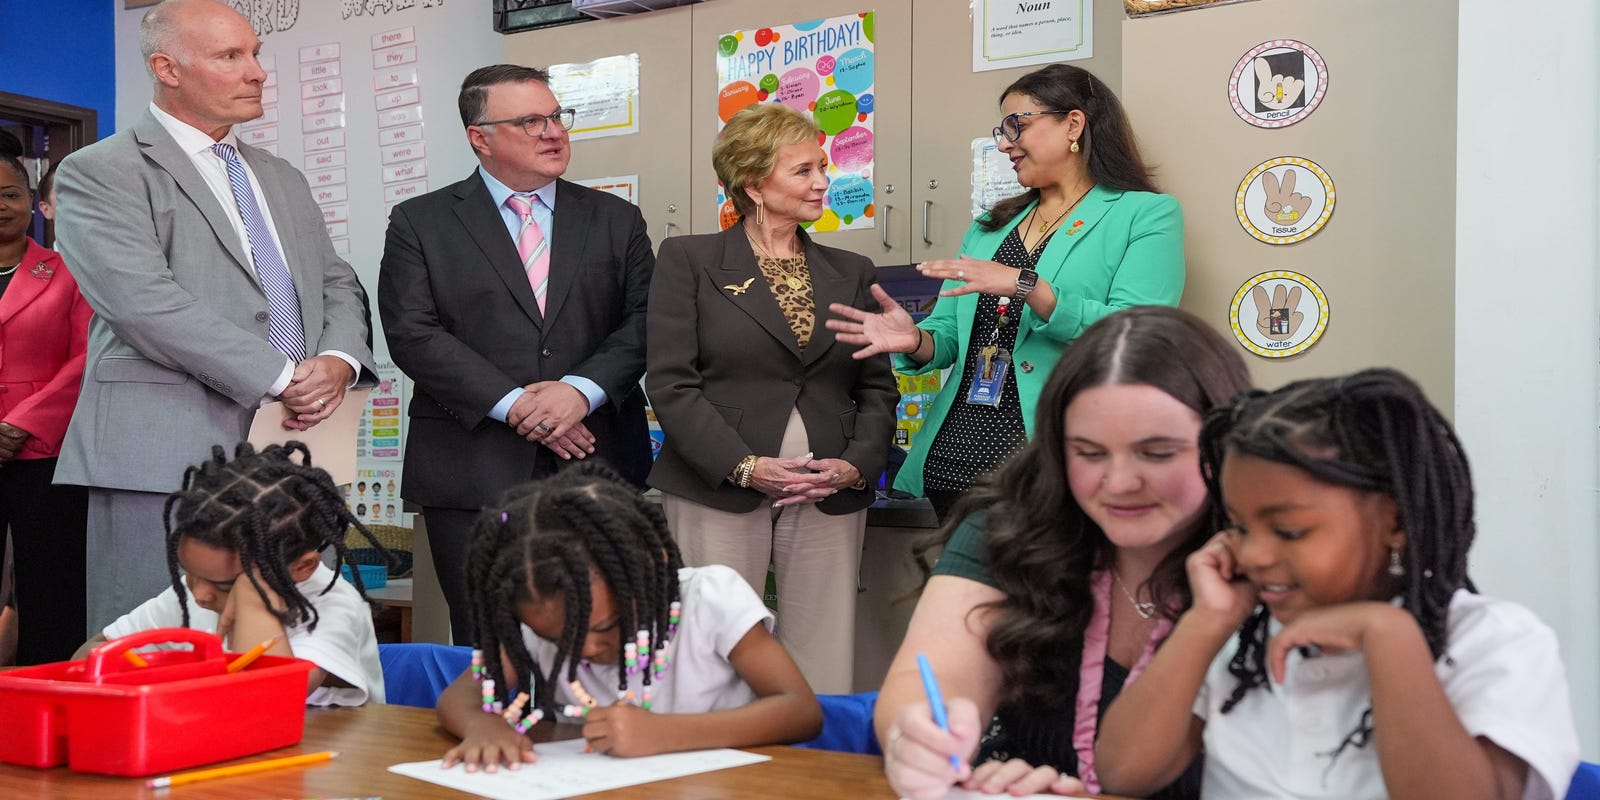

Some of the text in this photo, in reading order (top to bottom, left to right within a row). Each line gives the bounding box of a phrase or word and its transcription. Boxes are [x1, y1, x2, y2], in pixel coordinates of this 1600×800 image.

[1016, 1, 1051, 14] Noun
[381, 32, 402, 42] there
[728, 21, 860, 81] HAPPY BIRTHDAY!
[386, 54, 404, 63] they
[311, 67, 327, 75] little
[390, 74, 399, 82] to
[312, 83, 328, 92] look
[722, 85, 749, 98] January
[317, 99, 326, 108] of
[391, 96, 402, 104] up
[825, 95, 842, 105] June
[315, 117, 326, 126] on
[393, 130, 406, 139] we
[316, 136, 330, 145] out
[392, 148, 412, 158] were
[316, 154, 332, 164] said
[394, 166, 414, 177] what
[317, 173, 332, 182] see
[318, 190, 333, 201] she
[394, 186, 416, 196] when
[1271, 226, 1297, 234] Tissue
[1266, 340, 1293, 348] water
[358, 469, 396, 478] FEELINGS
